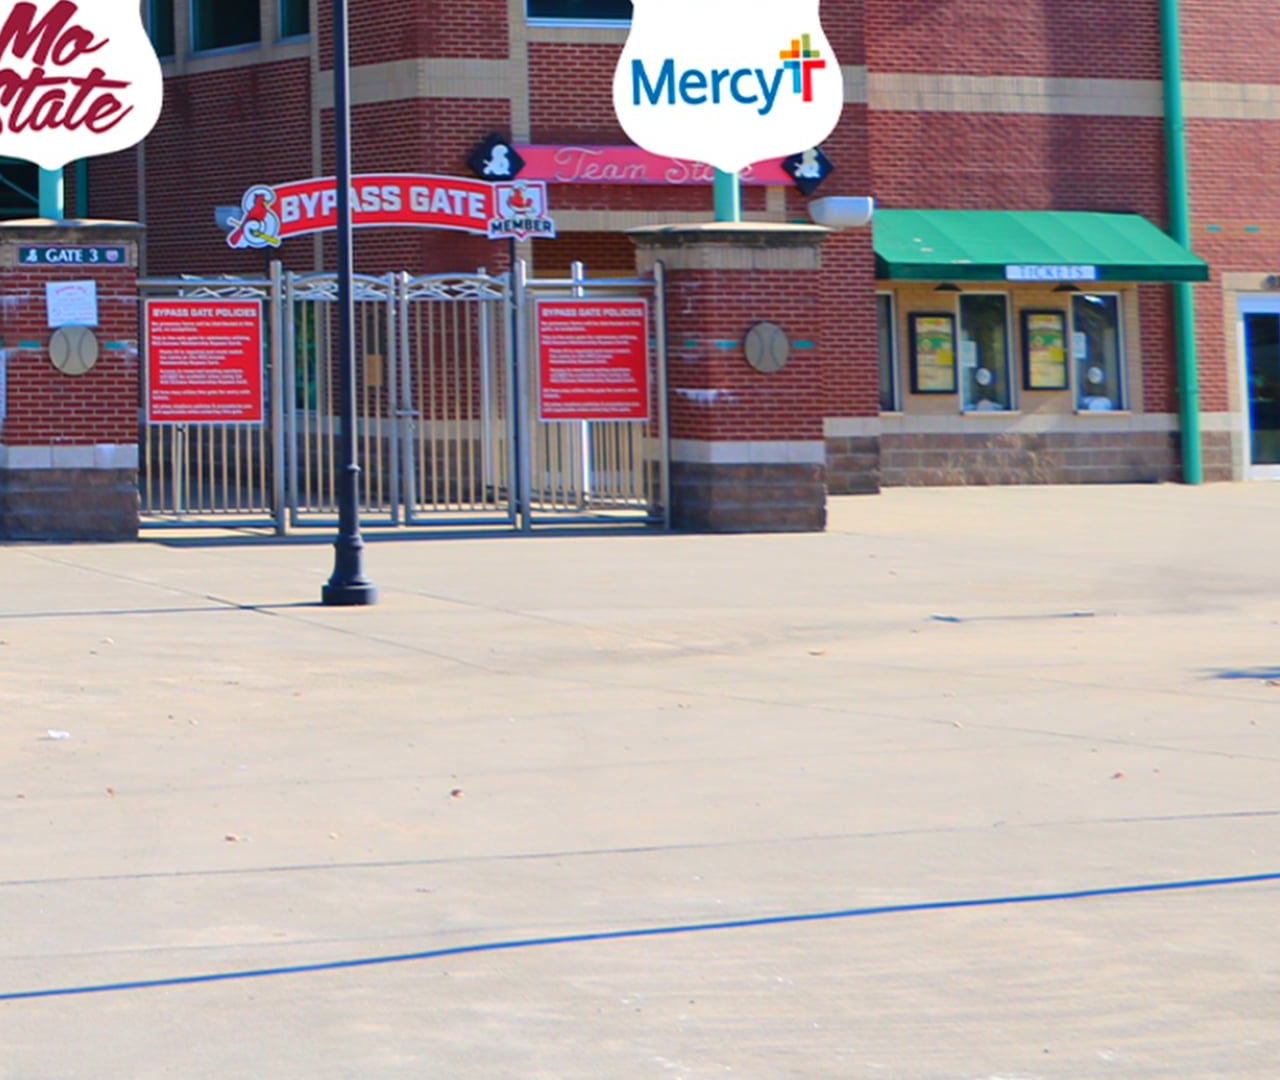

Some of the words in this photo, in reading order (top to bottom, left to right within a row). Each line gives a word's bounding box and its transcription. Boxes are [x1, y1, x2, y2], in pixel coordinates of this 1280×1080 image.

[631, 58, 785, 116] Mercy
[554, 146, 649, 182] Team
[409, 186, 487, 220] GATE
[491, 219, 552, 233] MEMBER
[45, 248, 83, 262] GATE
[89, 248, 99, 262] 3
[152, 308, 188, 317] BYPASS
[191, 308, 213, 317] GATE
[215, 308, 257, 317] POLICIES
